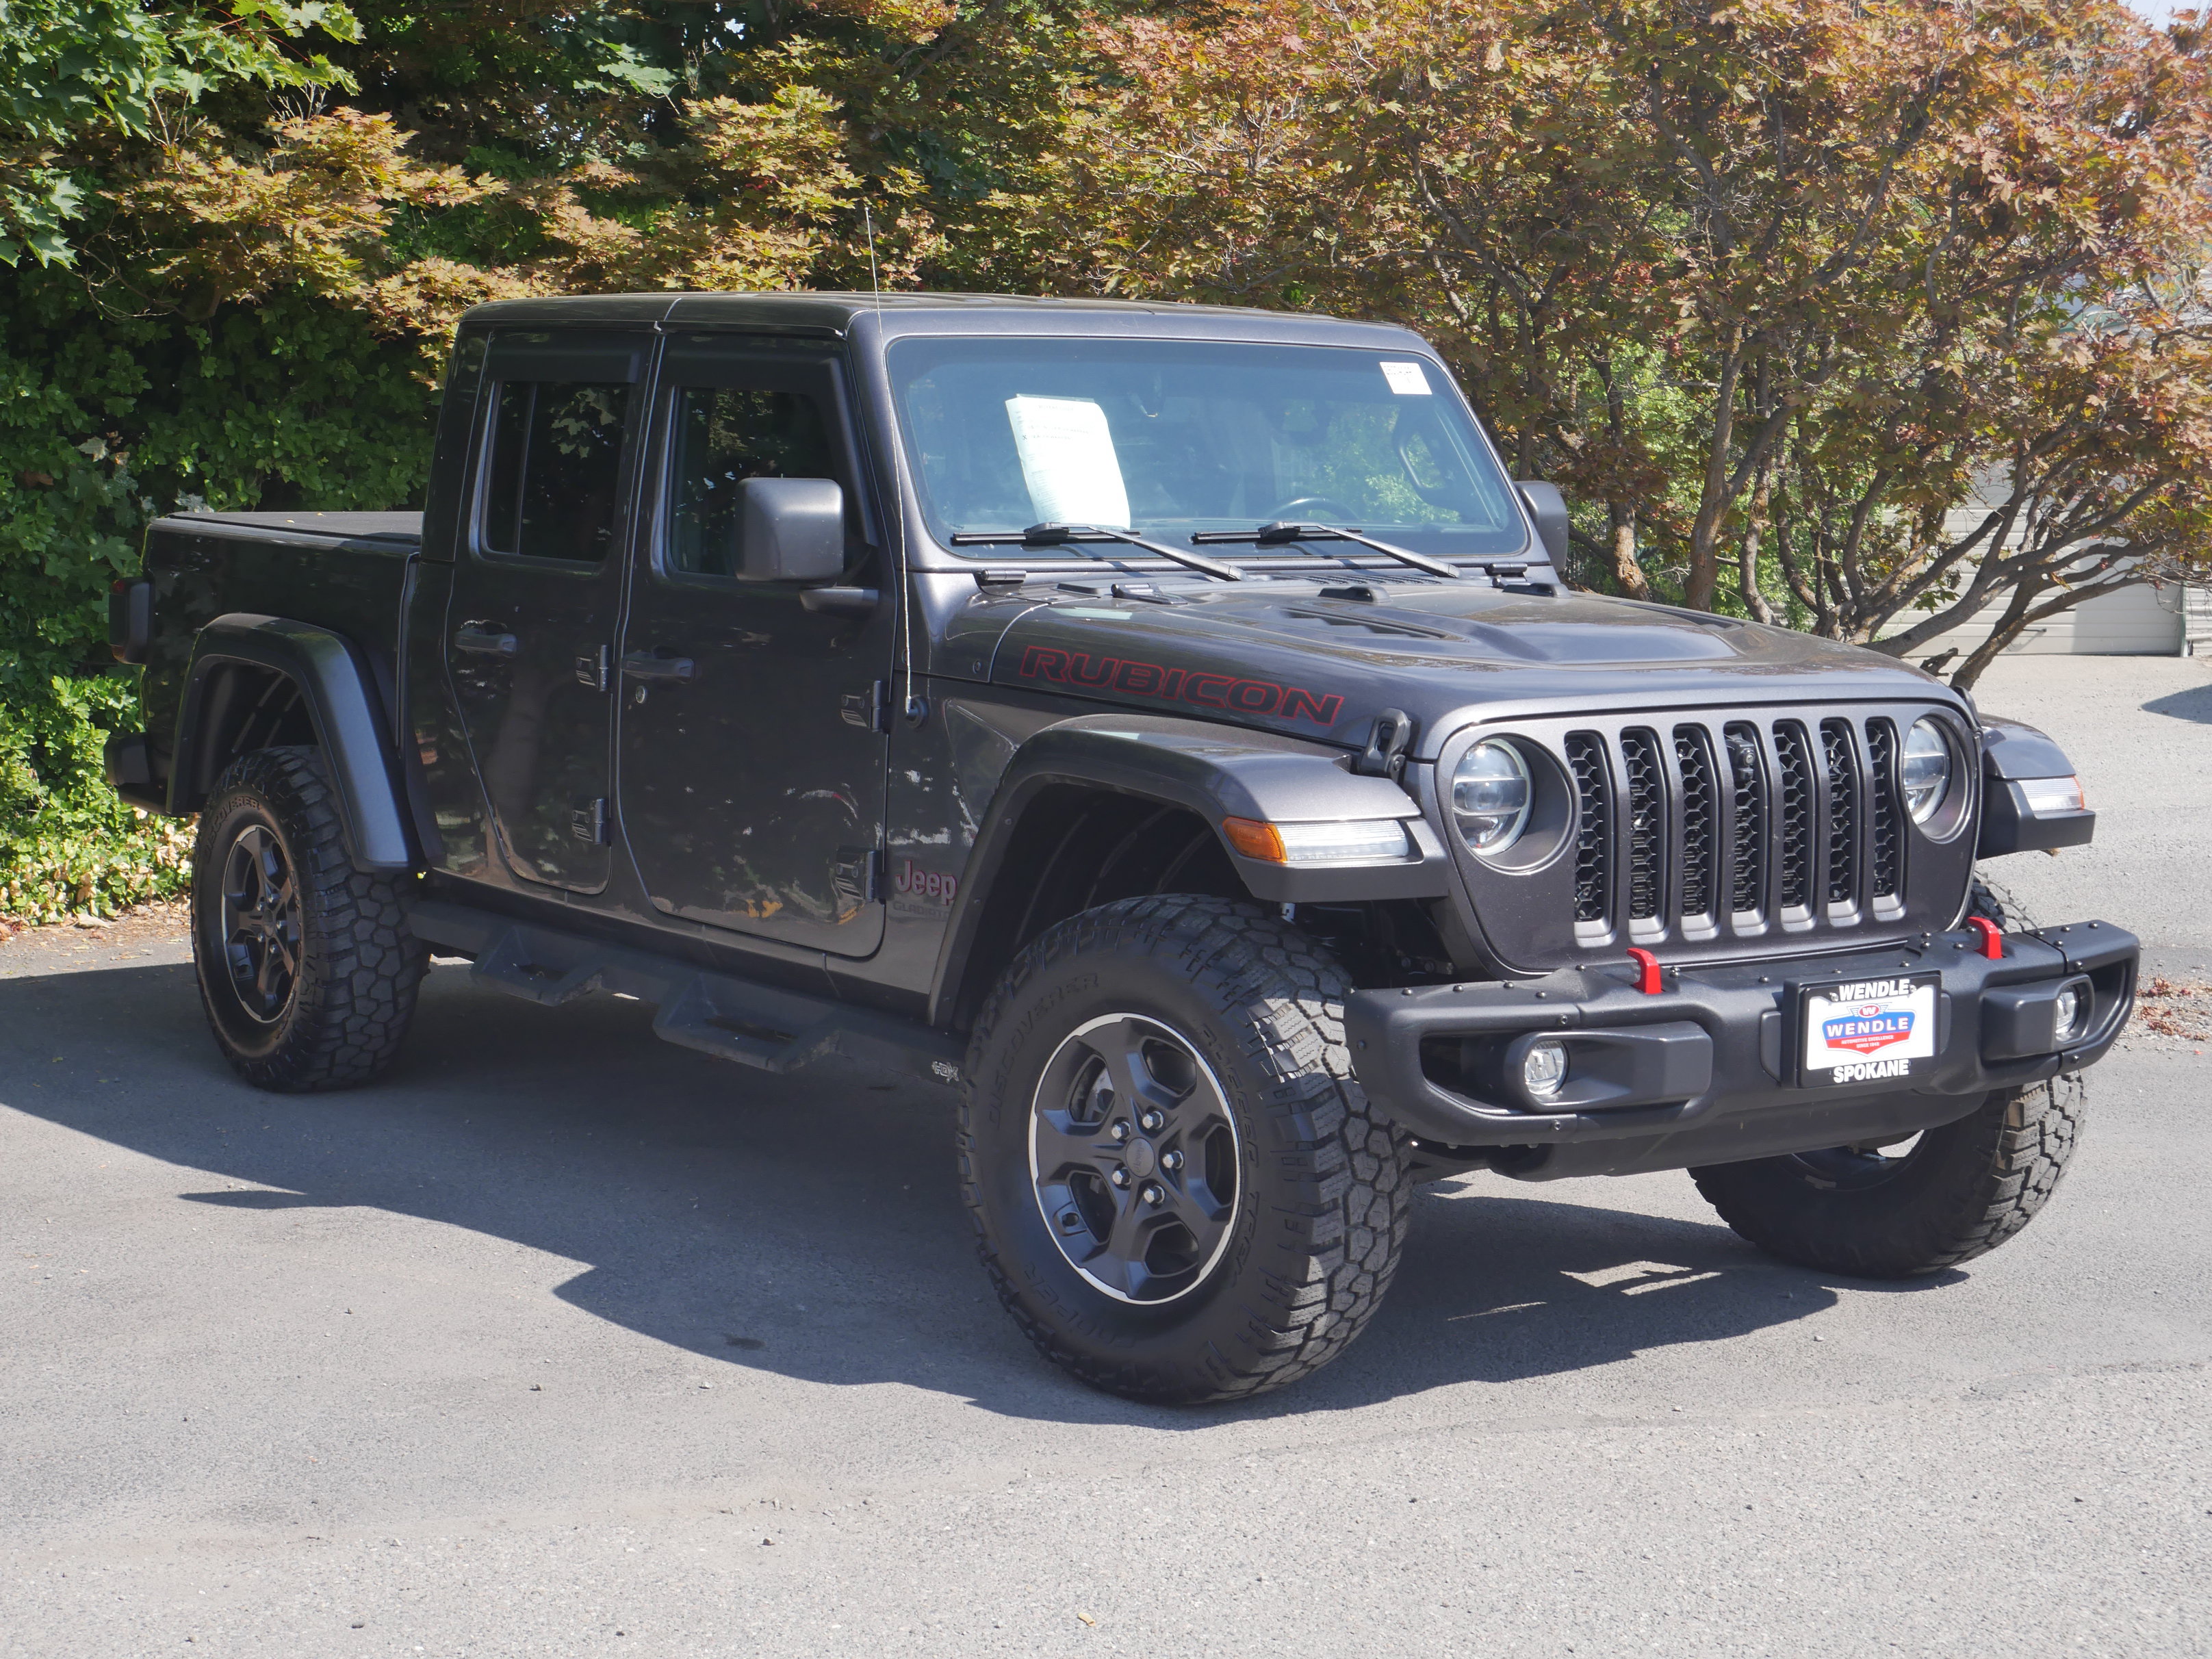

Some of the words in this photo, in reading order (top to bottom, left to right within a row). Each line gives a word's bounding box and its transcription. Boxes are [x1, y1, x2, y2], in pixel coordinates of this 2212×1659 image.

[1020, 645, 1345, 726] RUBICON
[895, 860, 957, 905] Jeep
[1839, 979, 1910, 1001] WENDLE
[1862, 1007, 1877, 1016] W
[1827, 1018, 1908, 1037] WENDLE
[988, 972, 1099, 1130] DISCOVERER
[1834, 1059, 1909, 1083] SPOKANE
